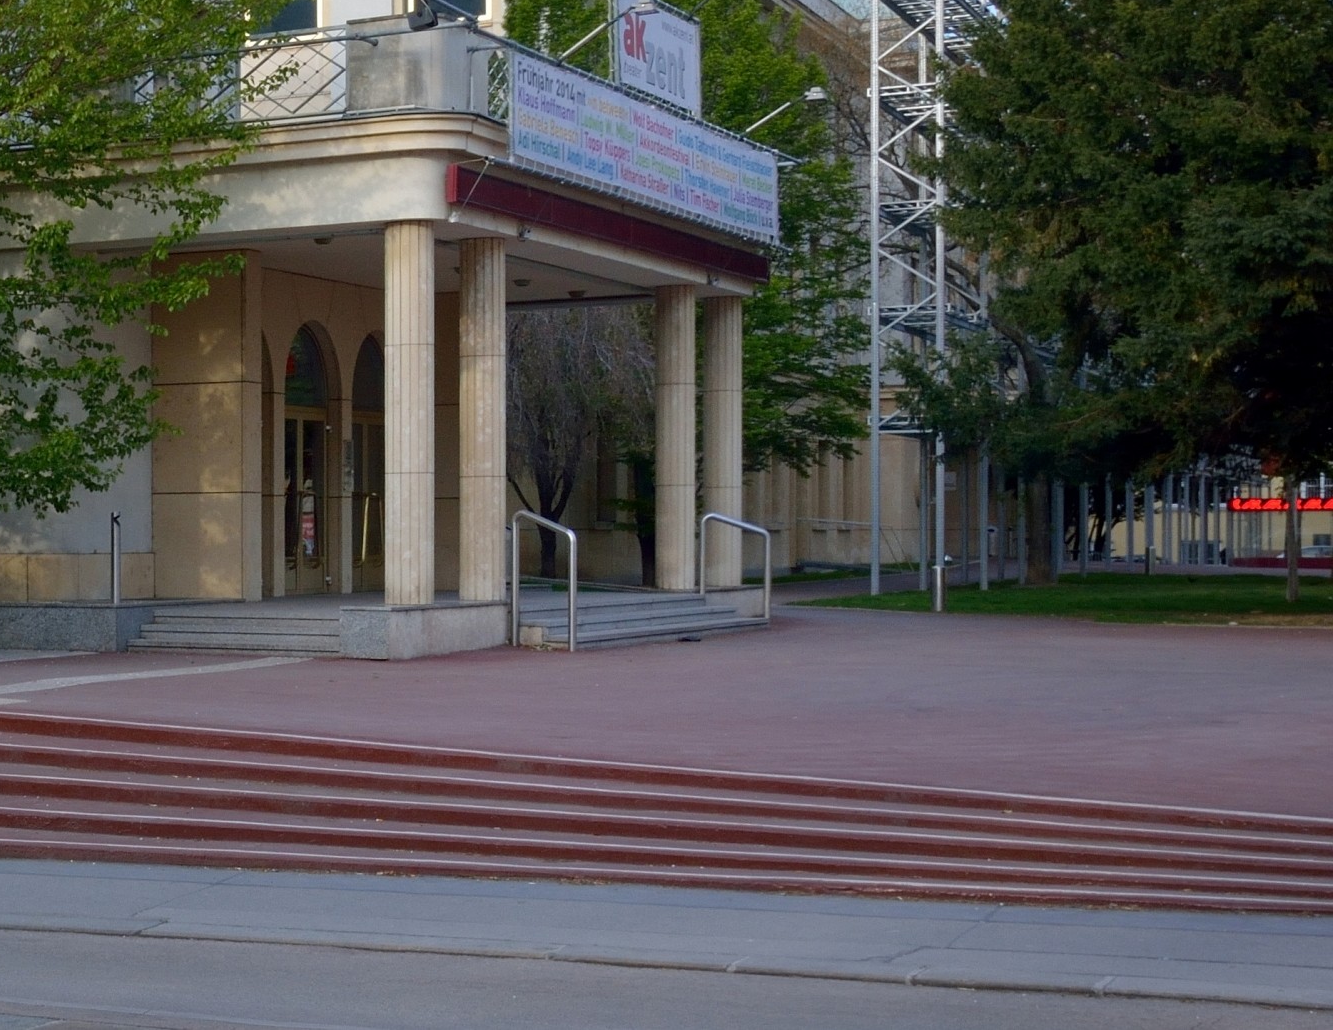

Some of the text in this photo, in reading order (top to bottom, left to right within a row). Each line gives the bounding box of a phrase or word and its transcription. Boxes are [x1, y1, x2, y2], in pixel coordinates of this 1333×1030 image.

[517, 60, 553, 99] Frühjahr
[556, 77, 574, 104] 2014
[633, 110, 645, 130] Wolf
[623, 12, 686, 100] akzent
[517, 84, 538, 109] Klaus
[541, 93, 574, 122] Hoffmann
[639, 132, 689, 166] Akkordeonfestival
[584, 130, 601, 155] Topsy
[605, 137, 631, 165] Küppers
[518, 128, 528, 150] Adi
[530, 133, 559, 160] Hirschal
[690, 189, 701, 207] Tim
[702, 193, 719, 213] Fischer
